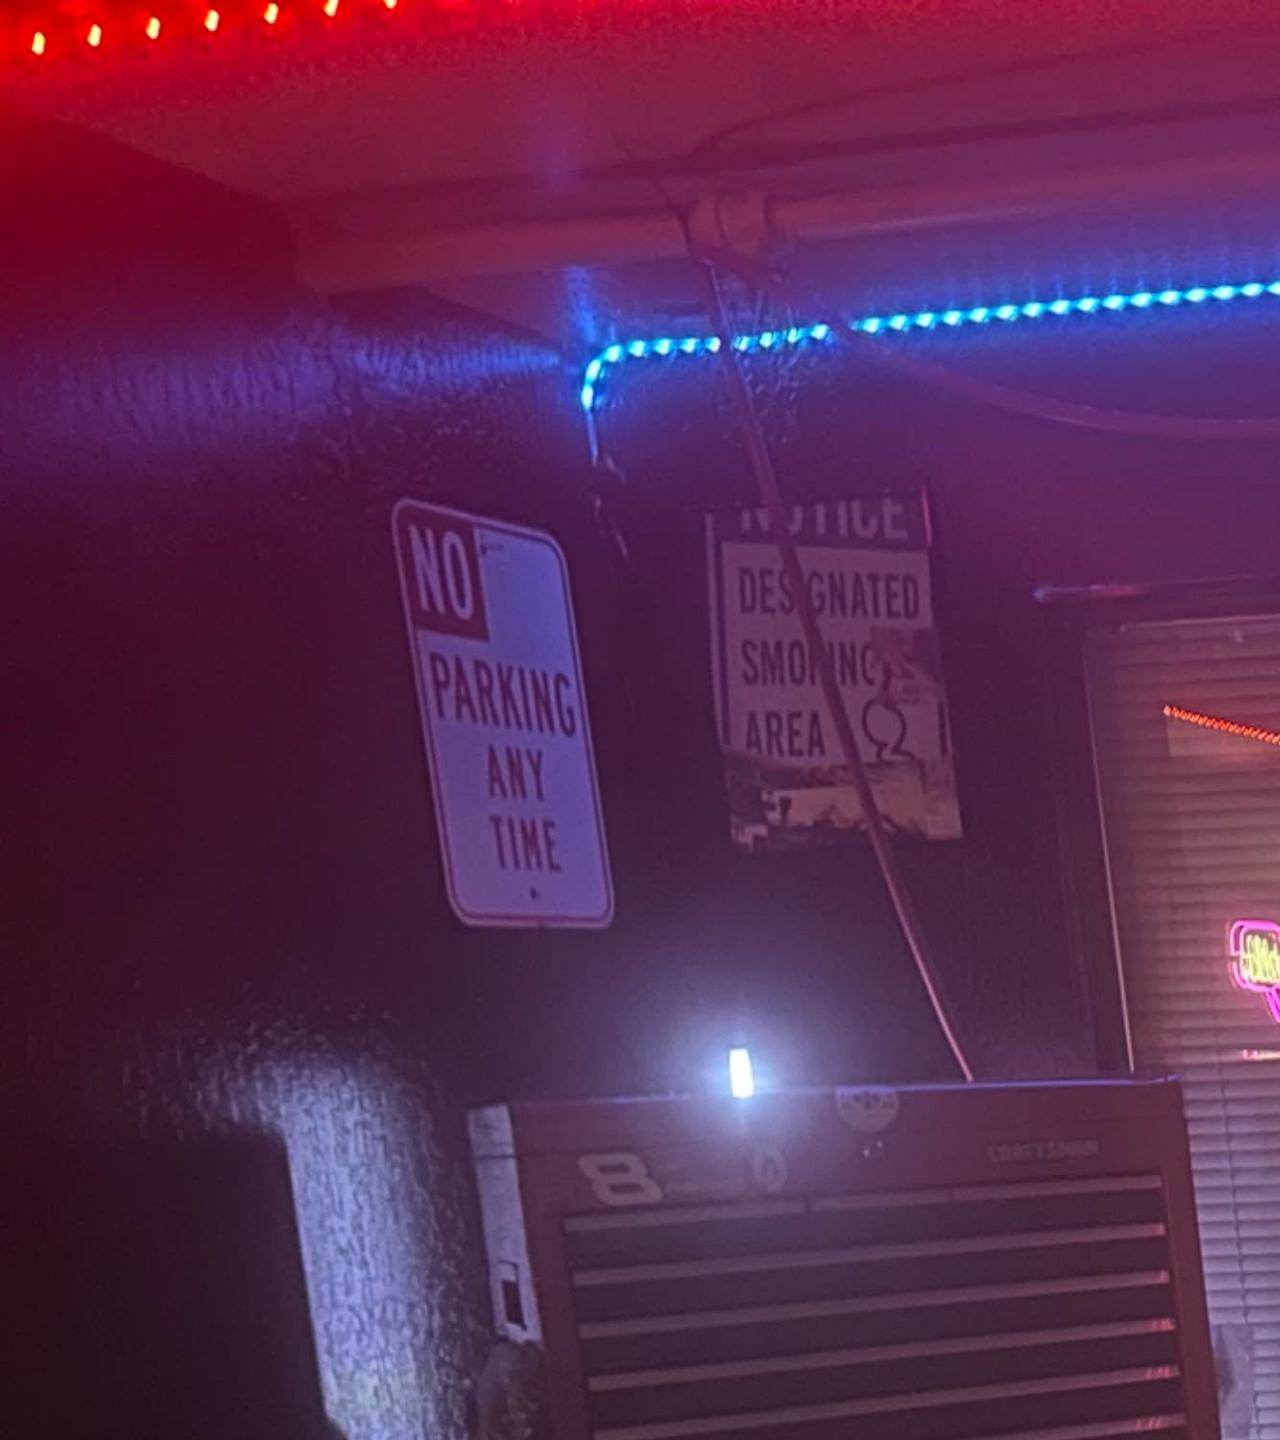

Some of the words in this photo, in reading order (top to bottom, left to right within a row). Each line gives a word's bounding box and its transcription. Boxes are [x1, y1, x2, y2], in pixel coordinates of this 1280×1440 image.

[408, 523, 473, 620] NO
[739, 566, 919, 619] DESGNATED
[429, 651, 576, 738] PARKING
[746, 711, 825, 757] AREA
[486, 743, 544, 801] ANY
[489, 814, 562, 873] TIME
